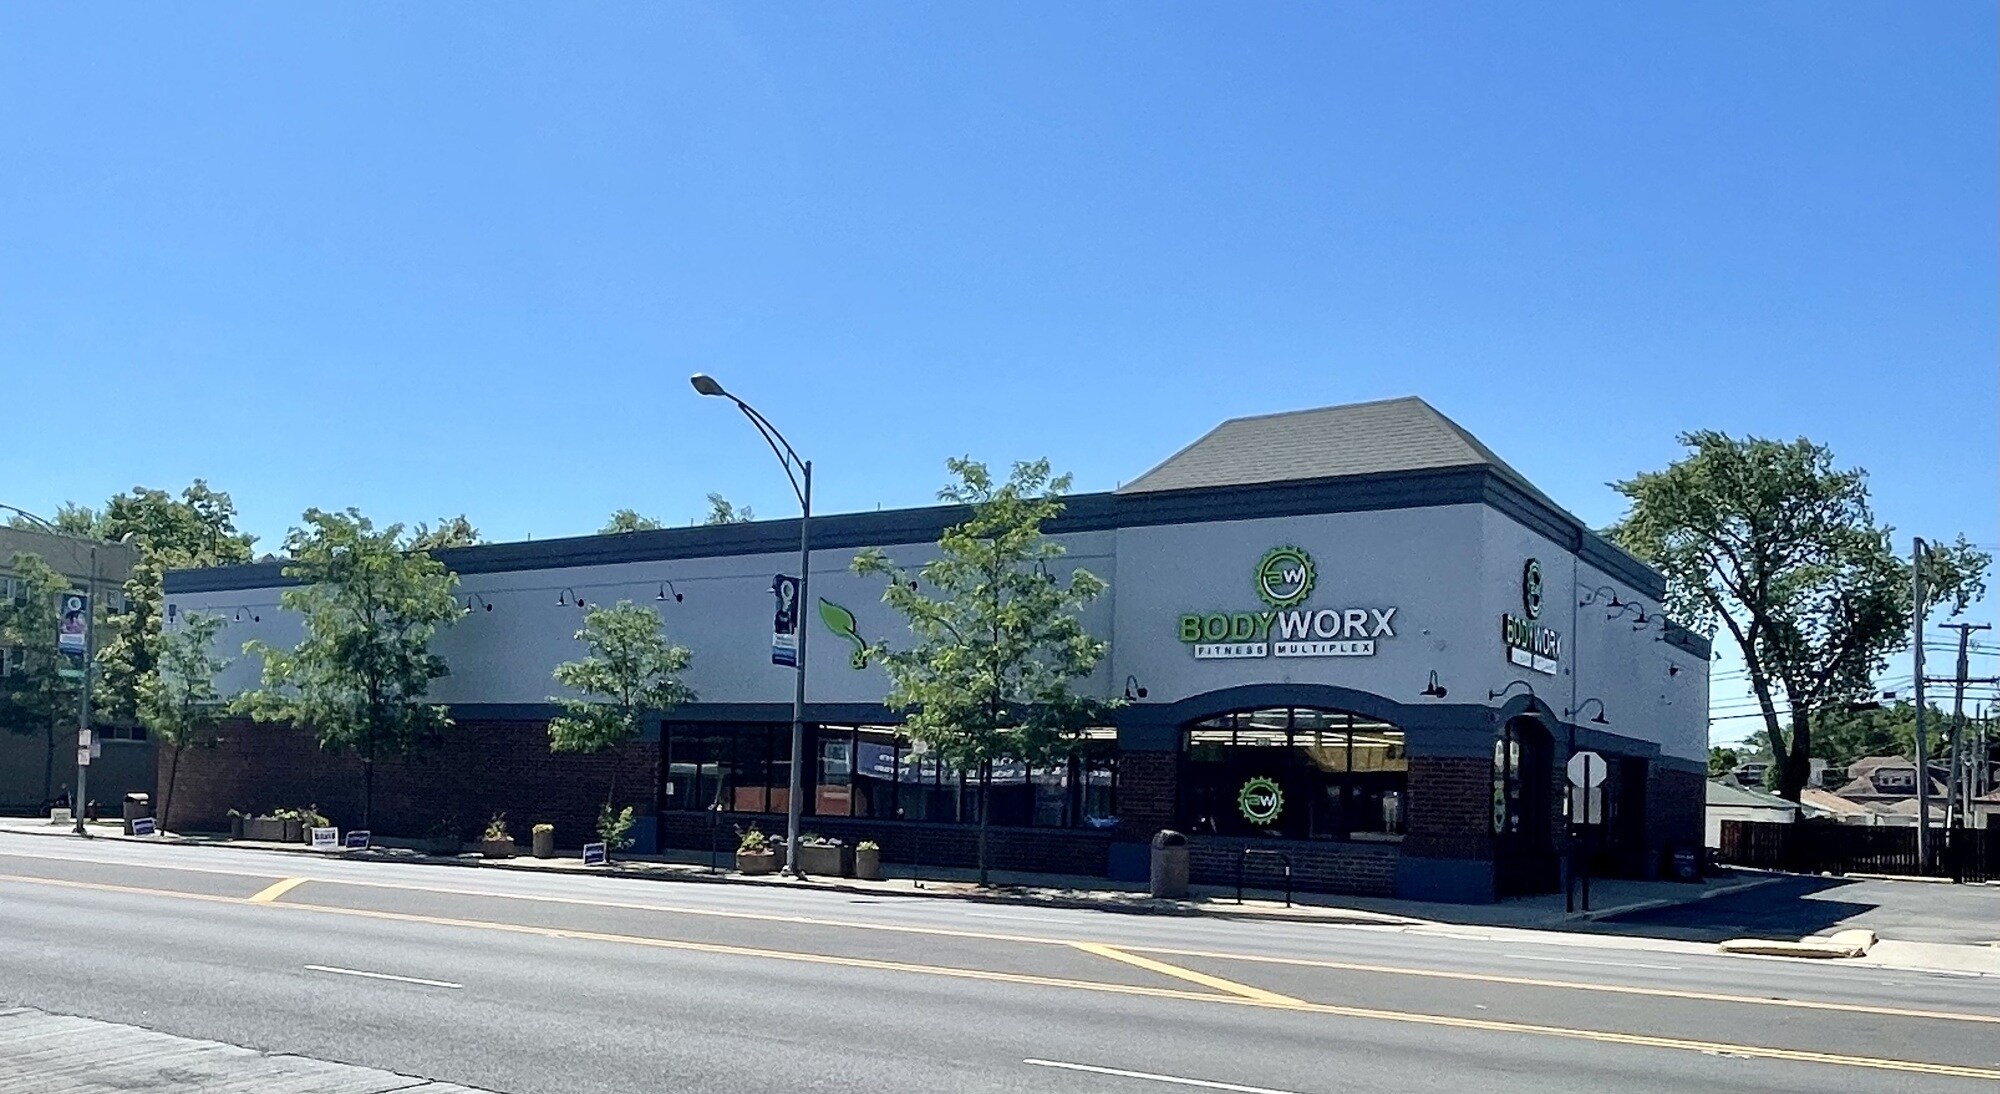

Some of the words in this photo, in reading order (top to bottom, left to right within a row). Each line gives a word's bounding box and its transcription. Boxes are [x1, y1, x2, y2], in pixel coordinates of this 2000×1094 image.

[1180, 608, 1398, 642] BODYWORX
[1198, 645, 1263, 656] FITNESS
[1278, 643, 1369, 654] MULTIPLEX
